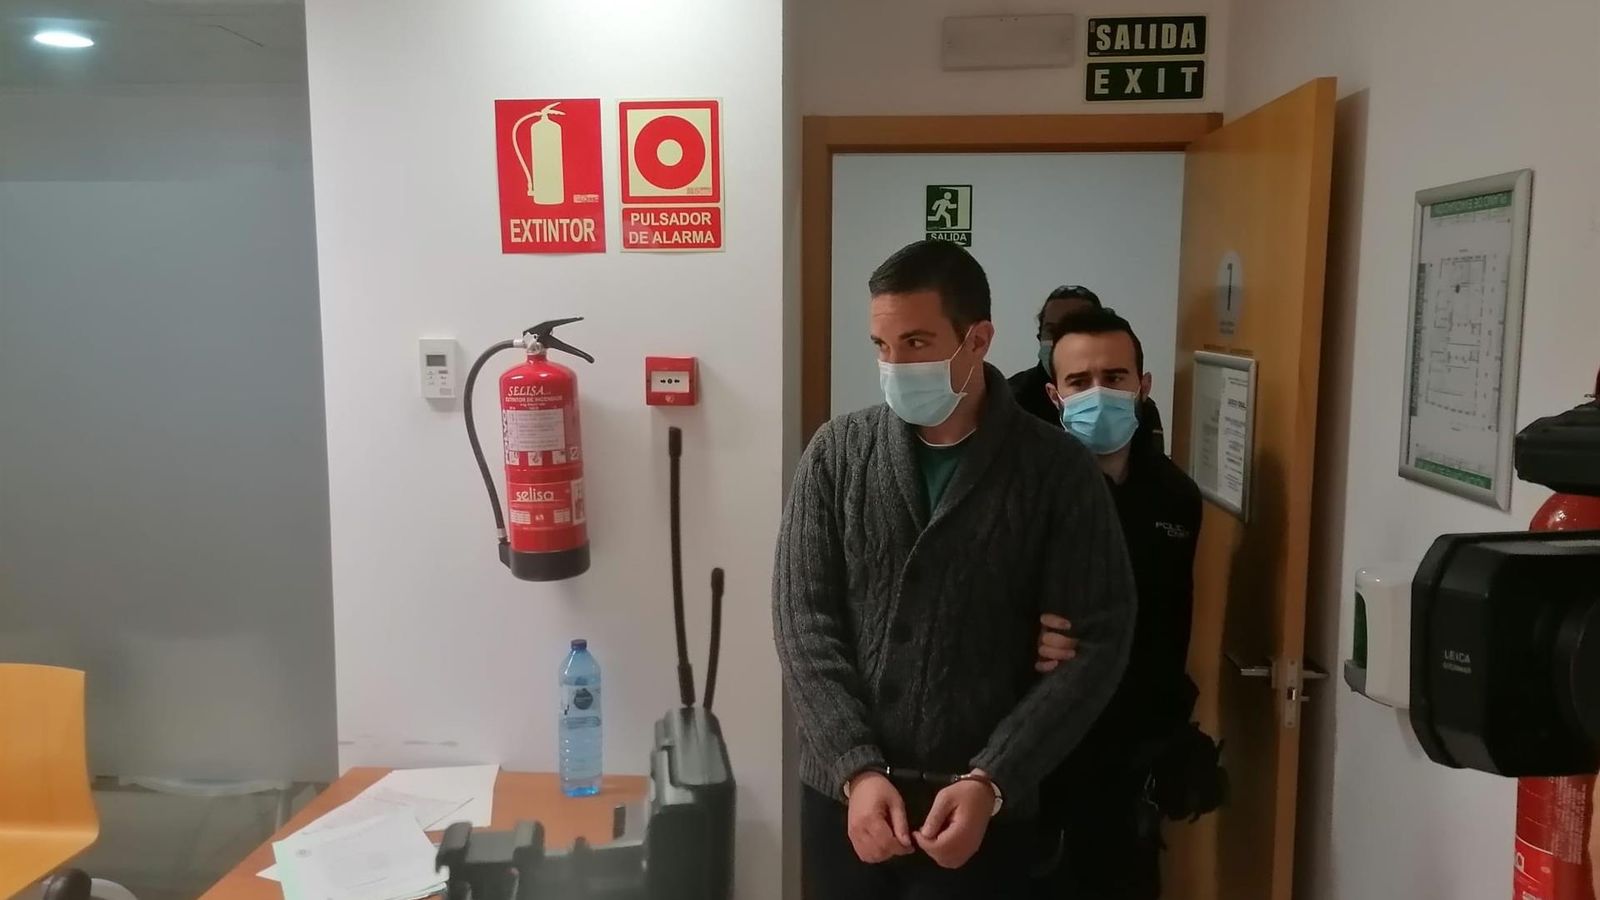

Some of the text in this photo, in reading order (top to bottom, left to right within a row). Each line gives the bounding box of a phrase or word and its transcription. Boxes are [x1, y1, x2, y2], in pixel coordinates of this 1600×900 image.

[1096, 22, 1197, 51] SALIDA
[1094, 67, 1198, 95] EXIT
[630, 212, 712, 226] PULSADOR
[510, 218, 596, 243] EXTINTOR
[629, 230, 715, 244] DE ALARMA
[930, 233, 967, 242] SALIDA
[508, 385, 544, 396] SELISA
[516, 487, 554, 501] selisa
[1444, 649, 1471, 663] LEICA
